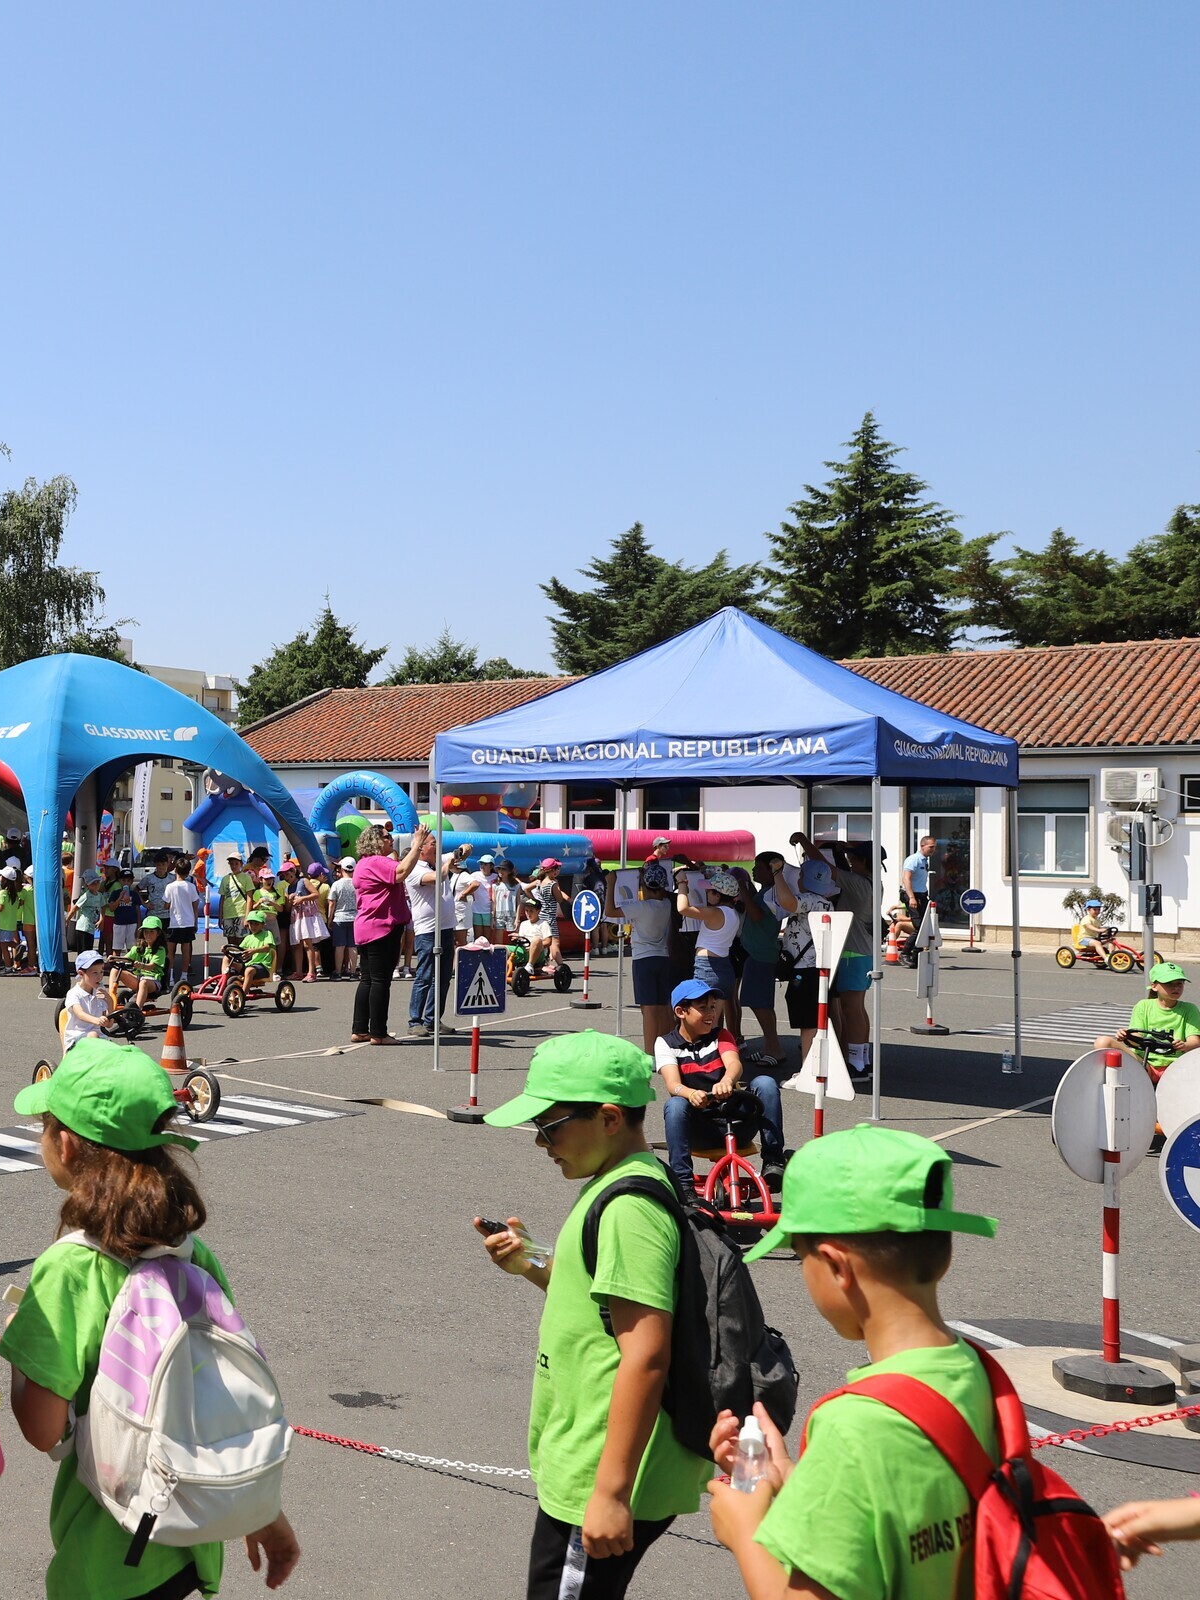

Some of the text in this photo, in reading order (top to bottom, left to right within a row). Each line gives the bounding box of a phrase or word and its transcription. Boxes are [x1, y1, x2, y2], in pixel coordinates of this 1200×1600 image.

[84, 723, 171, 741] GLASSDRIVE
[471, 737, 830, 765] GUARDA NACIONAL REPUBLICANA
[909, 1519, 956, 1565] FÉRIAS
